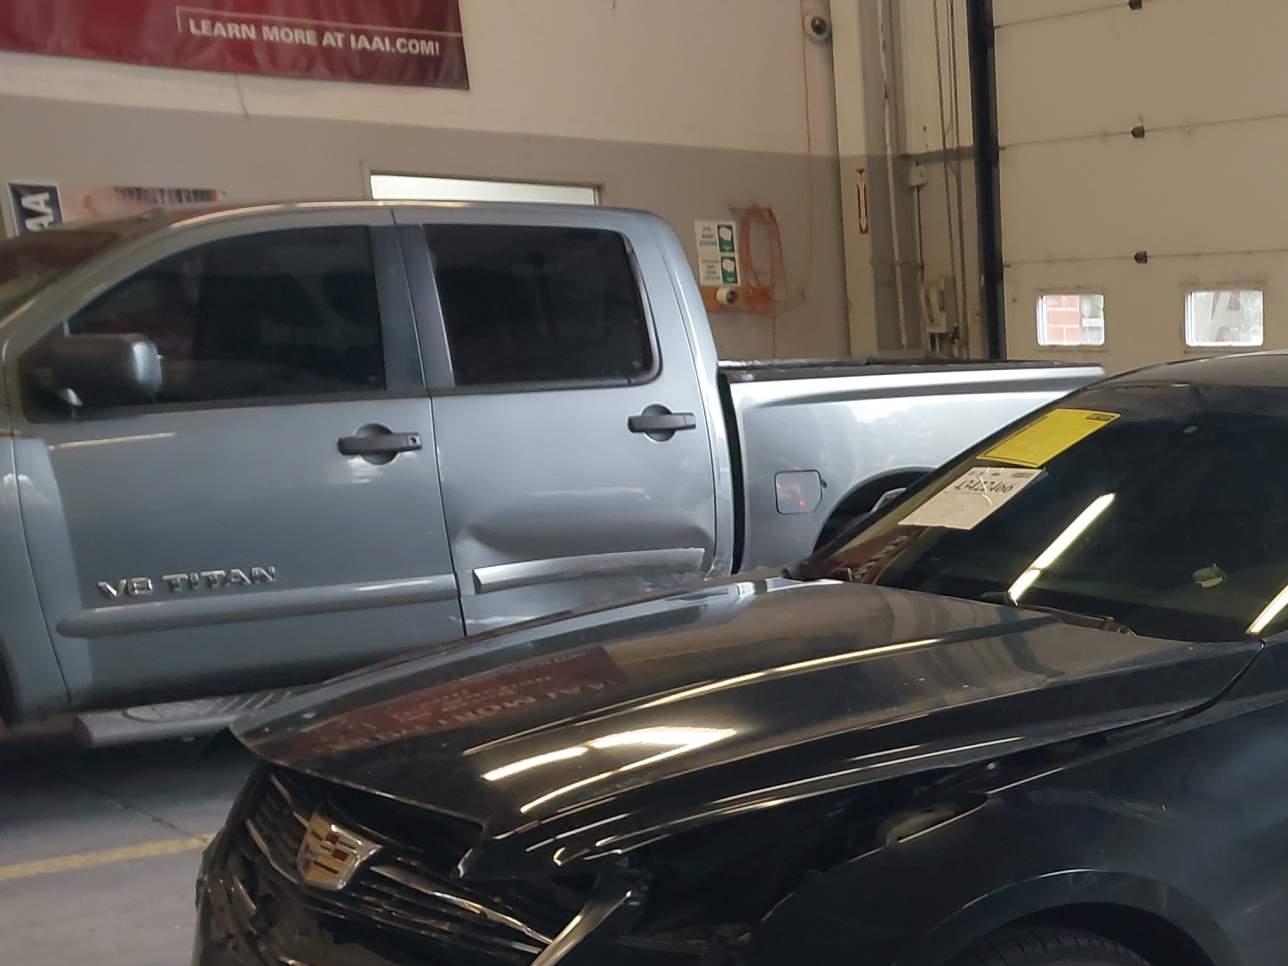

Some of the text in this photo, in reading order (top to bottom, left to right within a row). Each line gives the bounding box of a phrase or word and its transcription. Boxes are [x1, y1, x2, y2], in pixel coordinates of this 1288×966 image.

[188, 18, 440, 56] LEARN MORE AT IAAI.COM!
[97, 566, 277, 599] V8 TITAN
